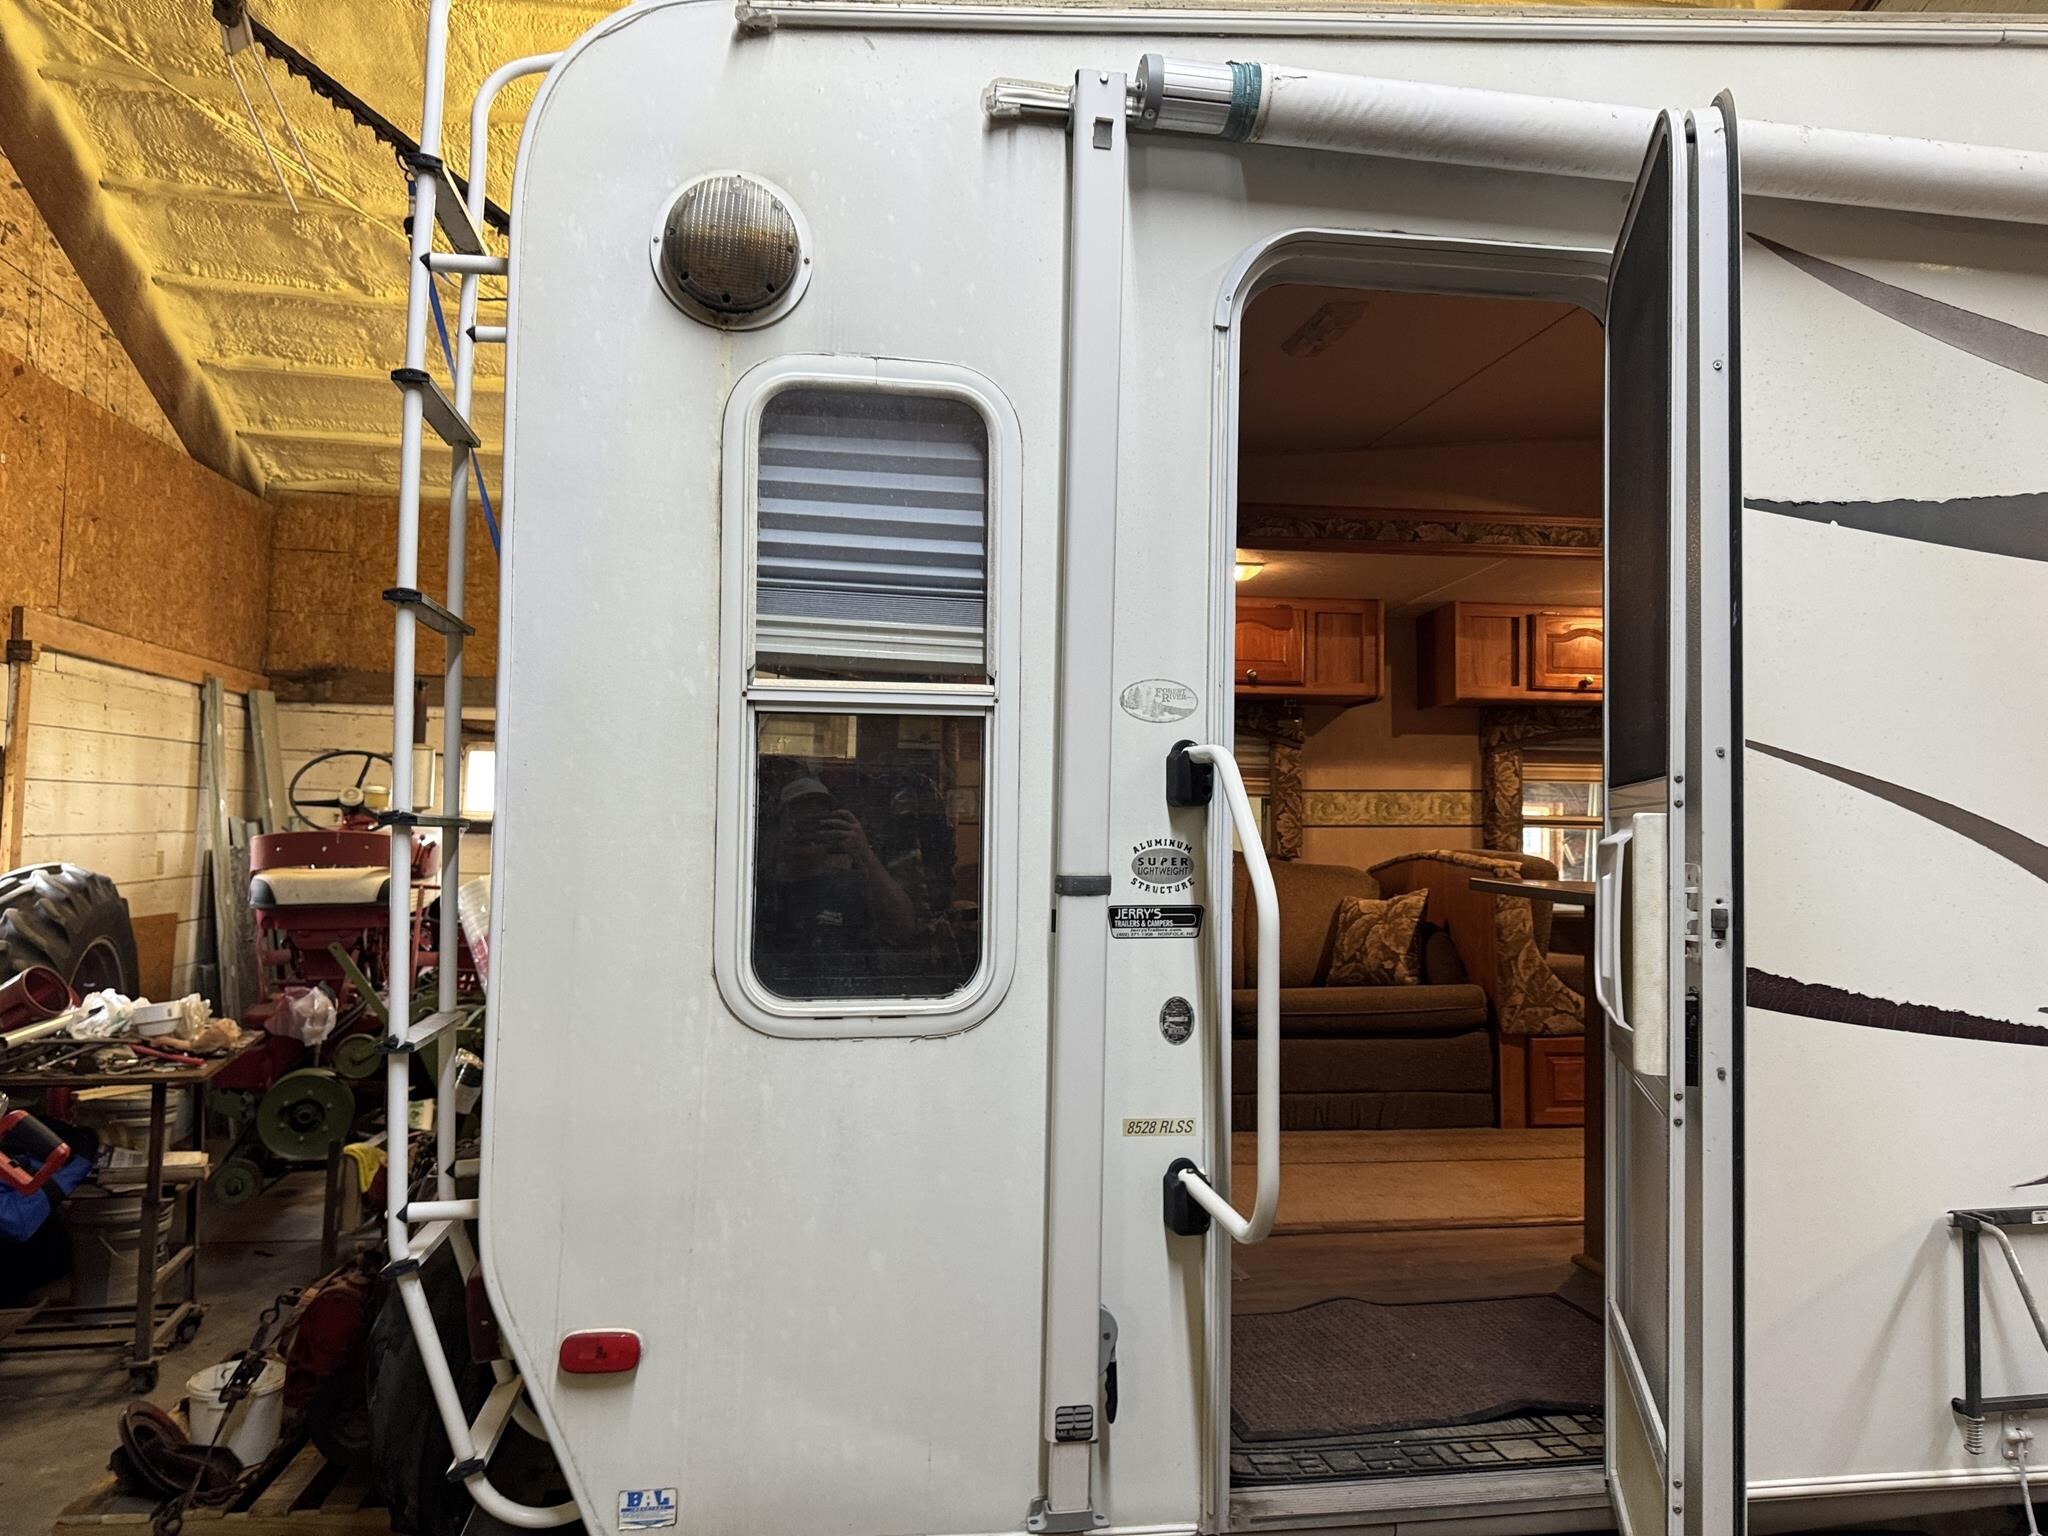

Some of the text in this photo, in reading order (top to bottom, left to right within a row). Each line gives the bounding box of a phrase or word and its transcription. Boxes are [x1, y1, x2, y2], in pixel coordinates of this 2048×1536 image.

[1161, 693, 1187, 702] RIVER
[1132, 839, 1193, 854] ALUMINUM
[1137, 856, 1189, 866] SUPER
[1137, 866, 1189, 876] LIGHTWEIGHT
[1130, 877, 1195, 895] STRUCTURE
[1114, 908, 1162, 919] JERRY'S
[1114, 919, 1140, 927] TRAILERS
[1147, 919, 1174, 927] CAMPERS
[1127, 1119, 1194, 1134] 8528 RLSS
